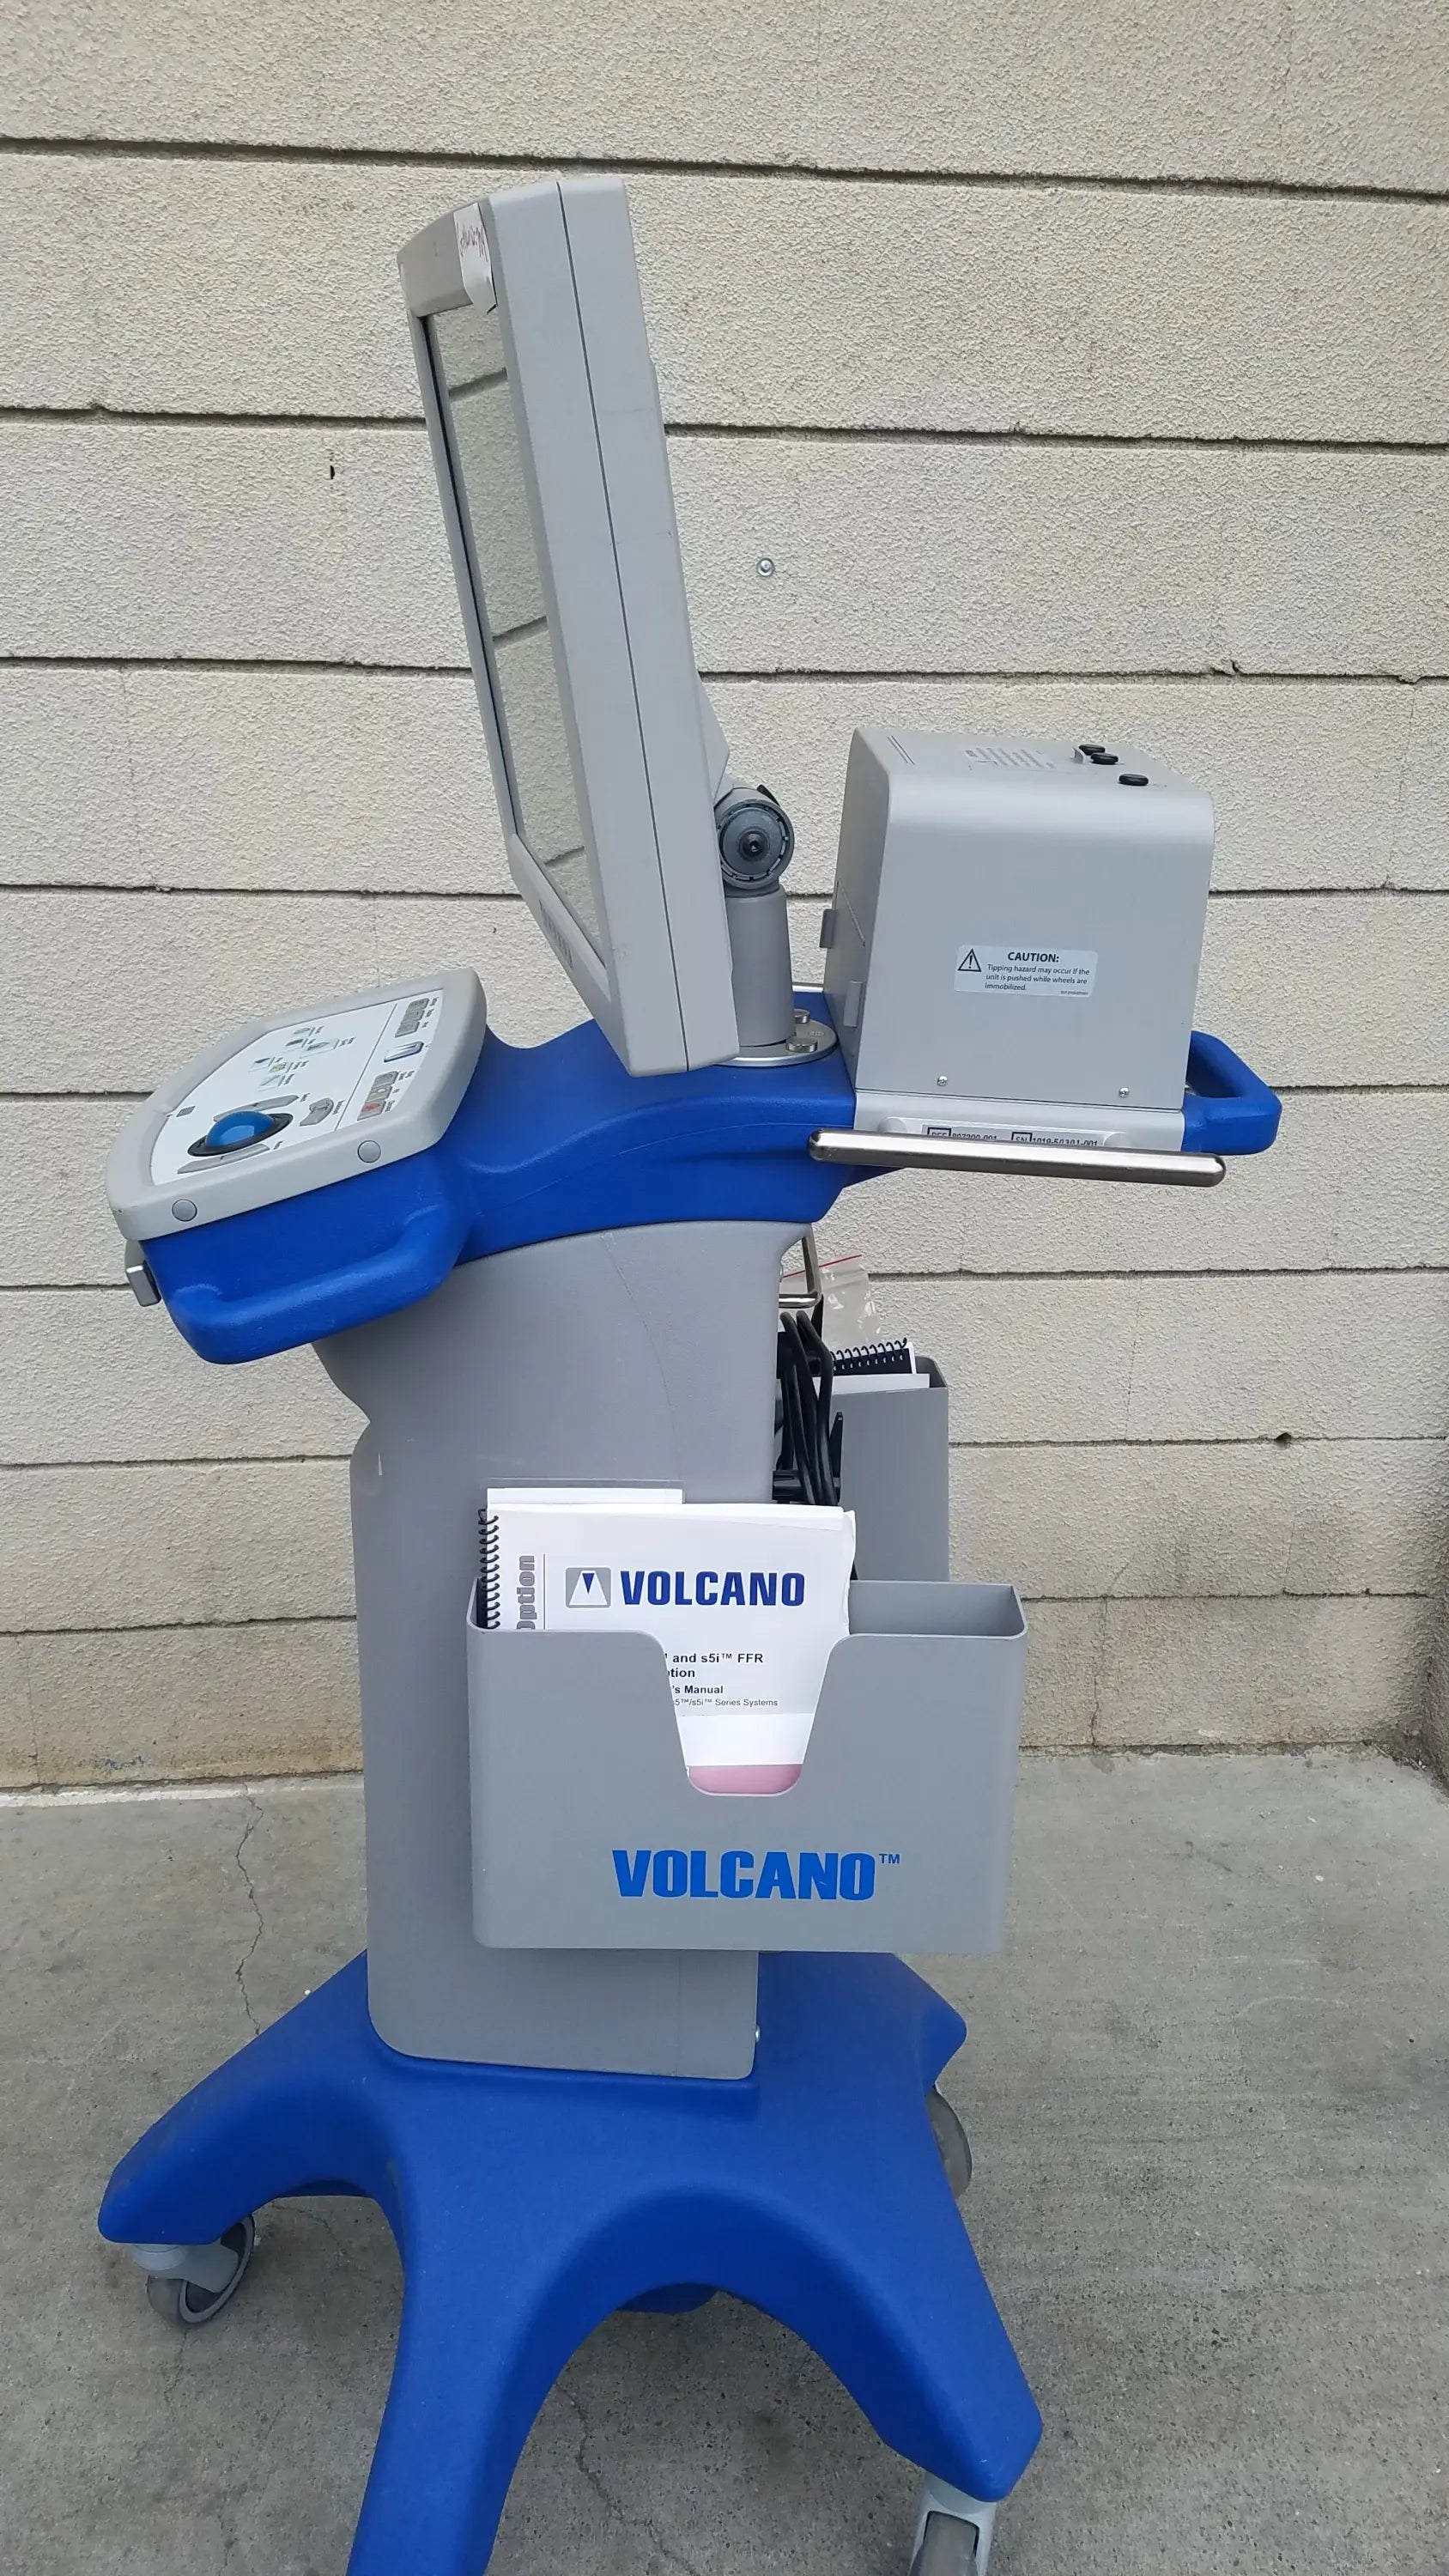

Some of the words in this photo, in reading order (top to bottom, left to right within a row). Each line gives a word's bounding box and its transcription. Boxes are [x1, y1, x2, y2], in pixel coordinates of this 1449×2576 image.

[1008, 952, 1059, 963] CAUTION:
[987, 964, 1012, 973] Tipping
[985, 981, 1027, 991] immobilized.
[620, 1571, 805, 1606] VOLCANO
[672, 1653, 697, 1663] and
[737, 1653, 764, 1663] FFR
[668, 1668, 695, 1678] tion
[684, 1685, 724, 1694] Manual
[715, 1698, 741, 1706] Series
[743, 1698, 779, 1707] Systems
